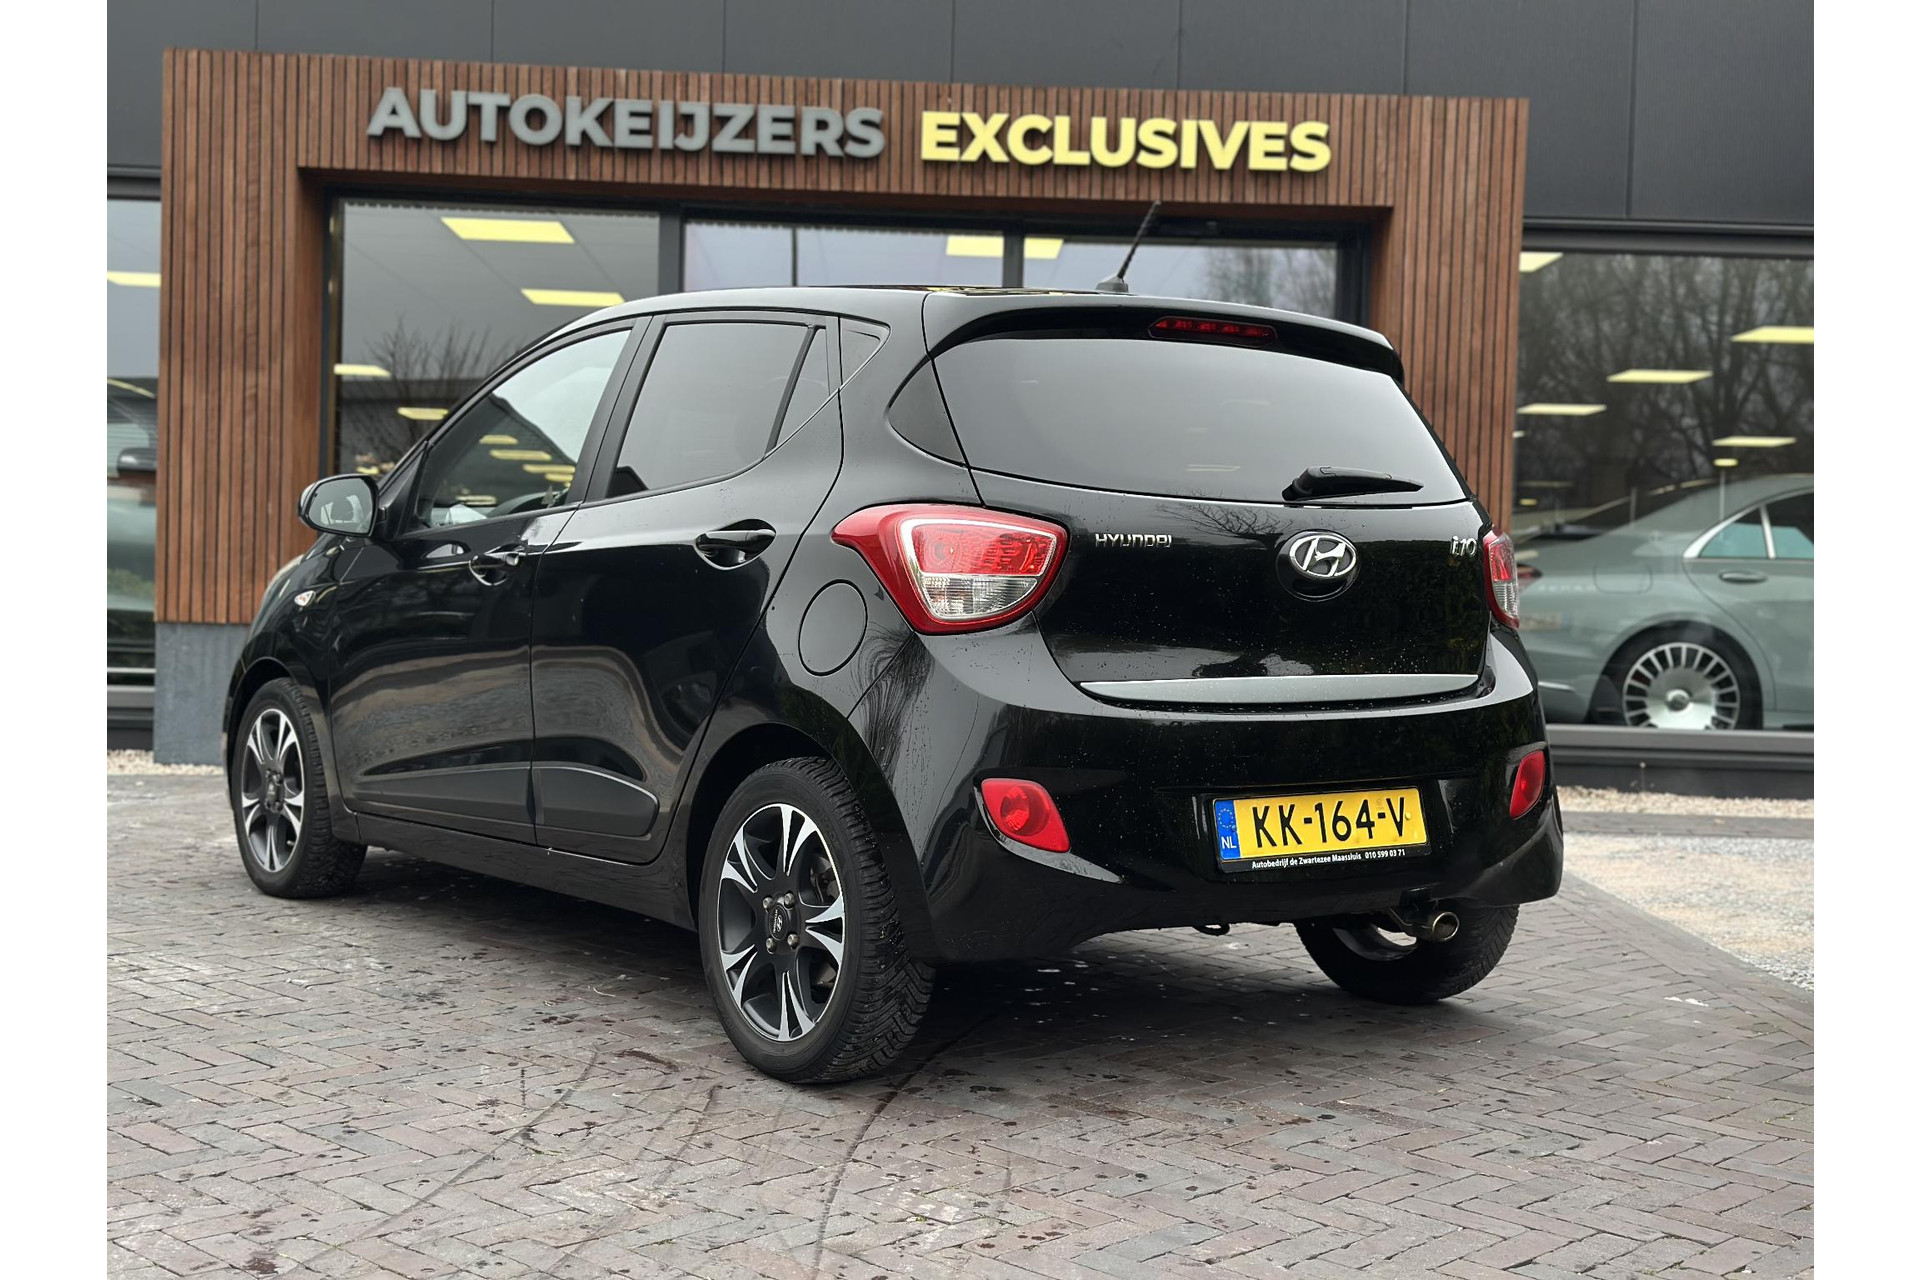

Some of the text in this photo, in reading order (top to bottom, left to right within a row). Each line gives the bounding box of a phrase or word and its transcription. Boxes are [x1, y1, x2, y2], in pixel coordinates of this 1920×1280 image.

[367, 87, 1332, 172] AUTOKEIJZERS EXCLUSIVES
[1095, 533, 1172, 547] HYUNDAI
[1452, 535, 1477, 556] i10
[1252, 797, 1405, 848] KK-164-V
[1221, 836, 1237, 849] NL
[1251, 858, 1289, 869] Autobedrijf
[1290, 857, 1298, 866] de
[1299, 856, 1331, 865] Zwartezee
[1365, 851, 1377, 859] 010
[1377, 850, 1389, 858] 599
[1389, 849, 1397, 857] 03
[1398, 848, 1406, 856] 71
